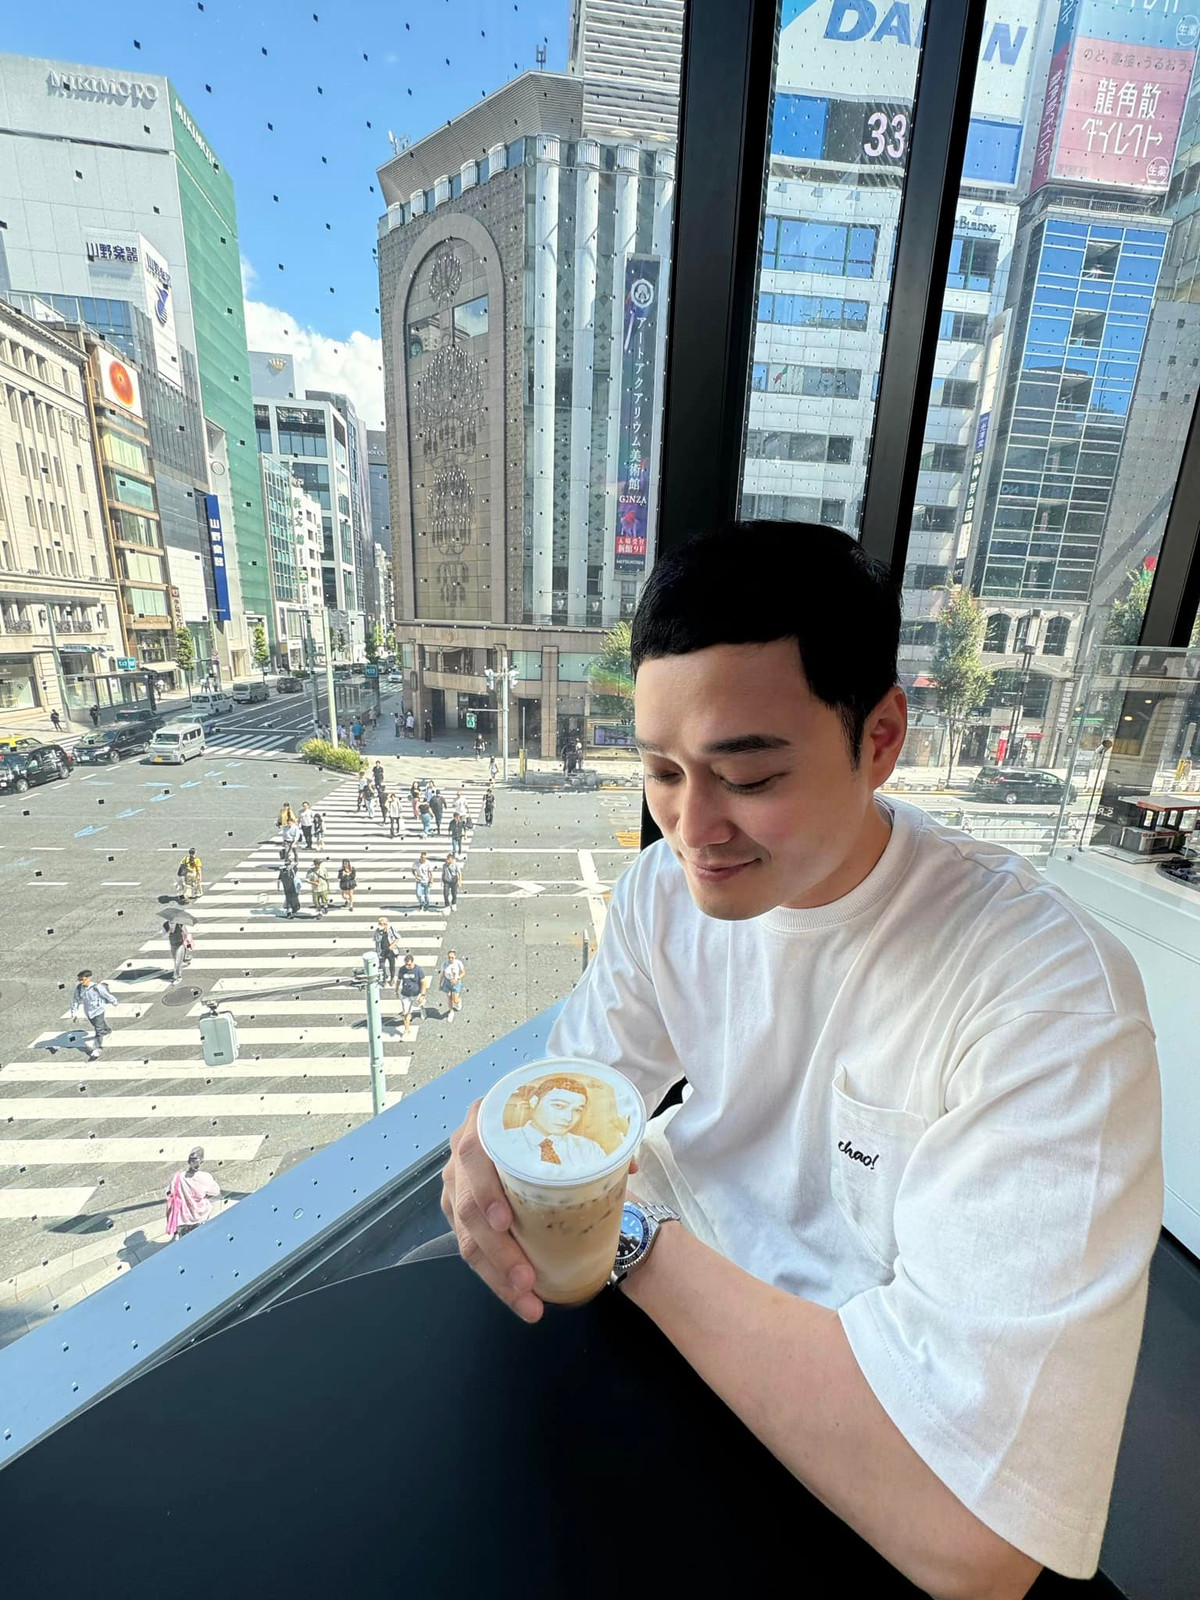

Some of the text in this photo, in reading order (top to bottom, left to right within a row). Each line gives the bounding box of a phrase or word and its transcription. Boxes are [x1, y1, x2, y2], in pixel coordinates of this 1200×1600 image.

[48, 71, 158, 100] MIKIMOTO
[1093, 77, 1162, 119] 龍角散
[864, 112, 907, 158] 33
[1082, 118, 1163, 158] ダイレクト
[86, 242, 138, 262] 山野楽器
[628, 317, 647, 490] アートアクアリウム美術館
[619, 495, 647, 504] GINZA
[838, 1141, 879, 1170] chao!
